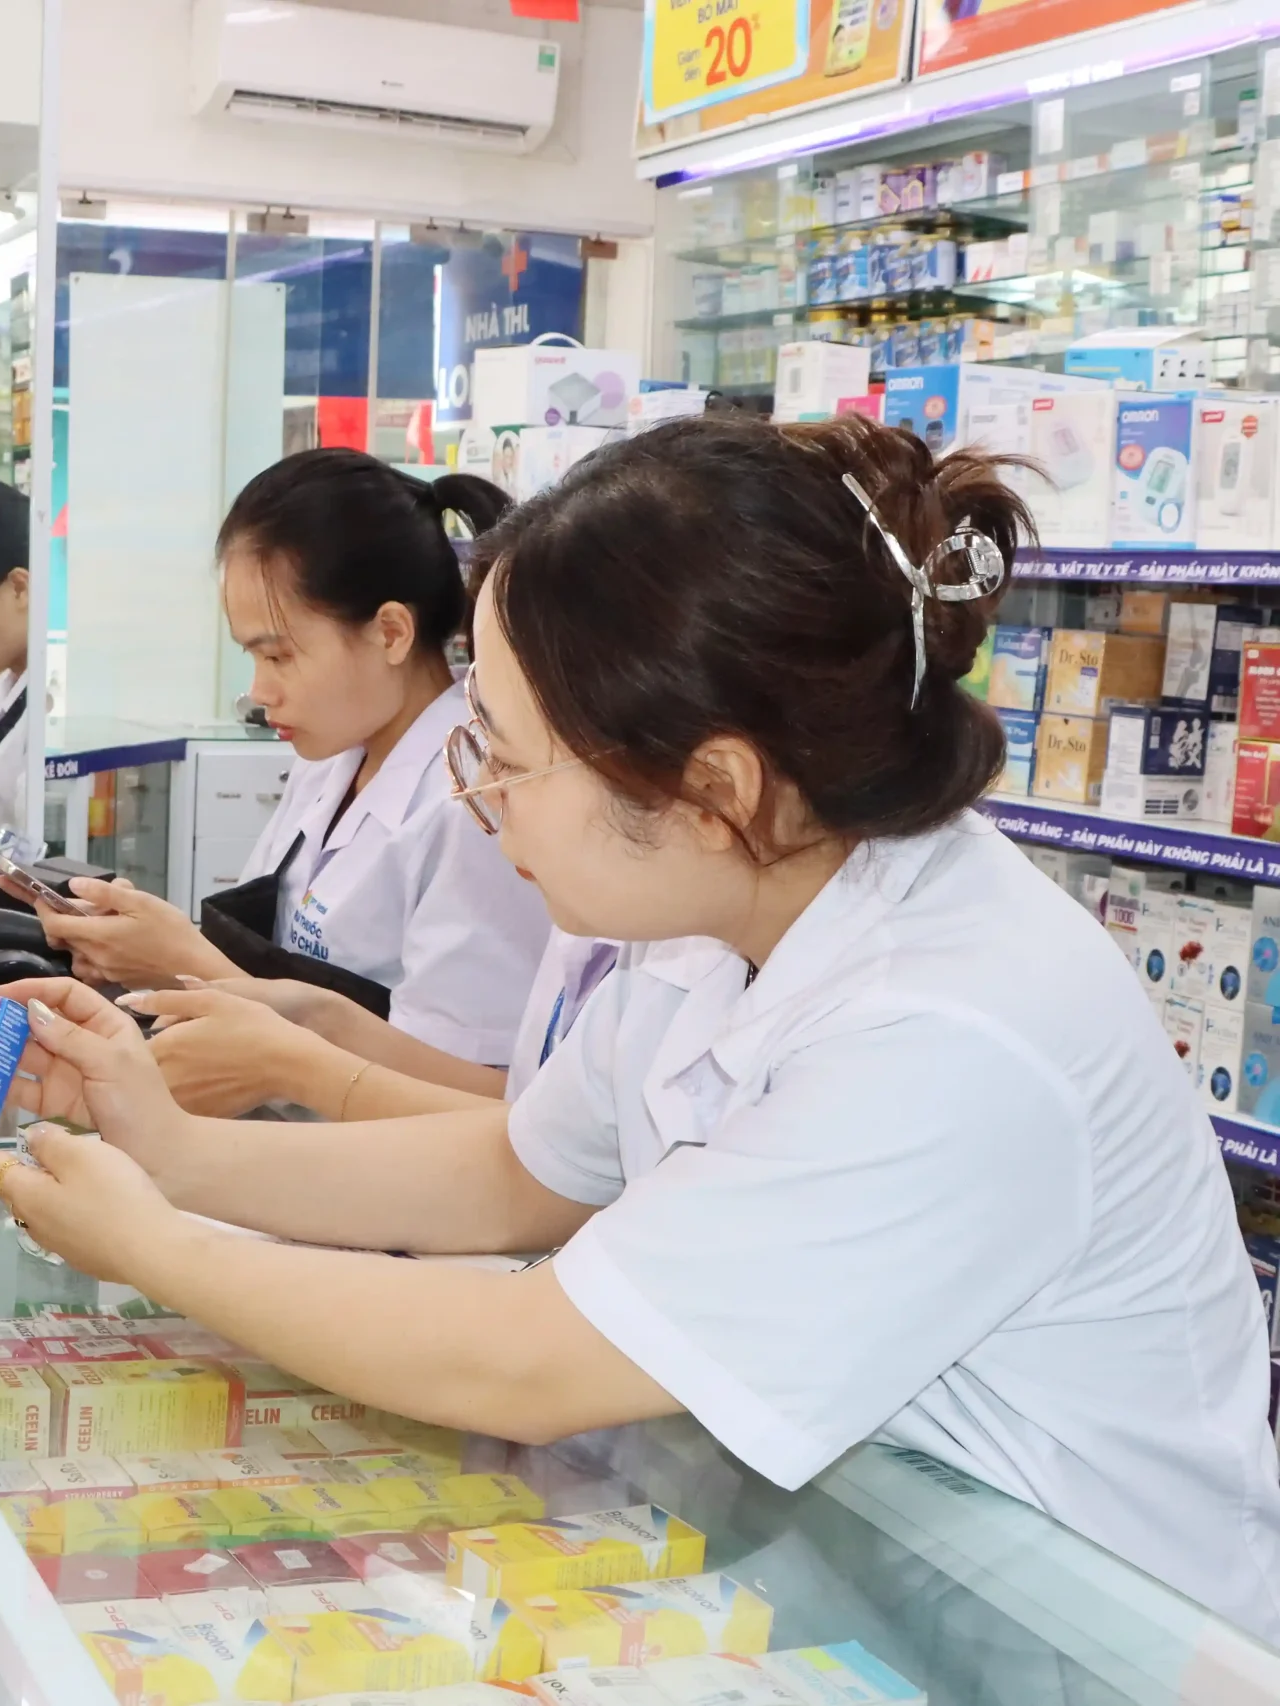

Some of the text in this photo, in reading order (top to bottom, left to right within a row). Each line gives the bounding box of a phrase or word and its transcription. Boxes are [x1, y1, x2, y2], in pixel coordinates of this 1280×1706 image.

[705, 17, 752, 86] 20
[465, 303, 499, 342] NHÀ
[438, 362, 475, 411] LO
[1139, 560, 1167, 577] SẢN
[1166, 560, 1206, 578] PHẨM
[1207, 562, 1239, 578] NÀY
[1239, 562, 1280, 579] KHÔN
[998, 816, 1029, 835] CHỨC
[1029, 821, 1064, 840] NĂNG
[1071, 827, 1097, 845] SẢN
[1098, 829, 1134, 852] PHẨM
[1135, 838, 1162, 856] NÀY
[1162, 843, 1210, 866] KHÔNG
[1211, 850, 1246, 870] PHẢI
[1246, 856, 1266, 875] LÀ
[297, 935, 329, 961] CHÂU
[1223, 1140, 1259, 1160] PHẢI
[1258, 1148, 1278, 1167] LÀ
[24, 1404, 40, 1452] CEELIN
[76, 1405, 93, 1453] CEELIN
[245, 1407, 281, 1426] ELIN
[311, 1403, 367, 1422] CEELIN
[63, 1490, 123, 1501] STRAWBERRY
[148, 1480, 202, 1494] ORANG
[604, 1510, 659, 1543] Bisolvon
[669, 1577, 721, 1613] Bisolvon
[194, 1622, 235, 1662] Bisolvon
